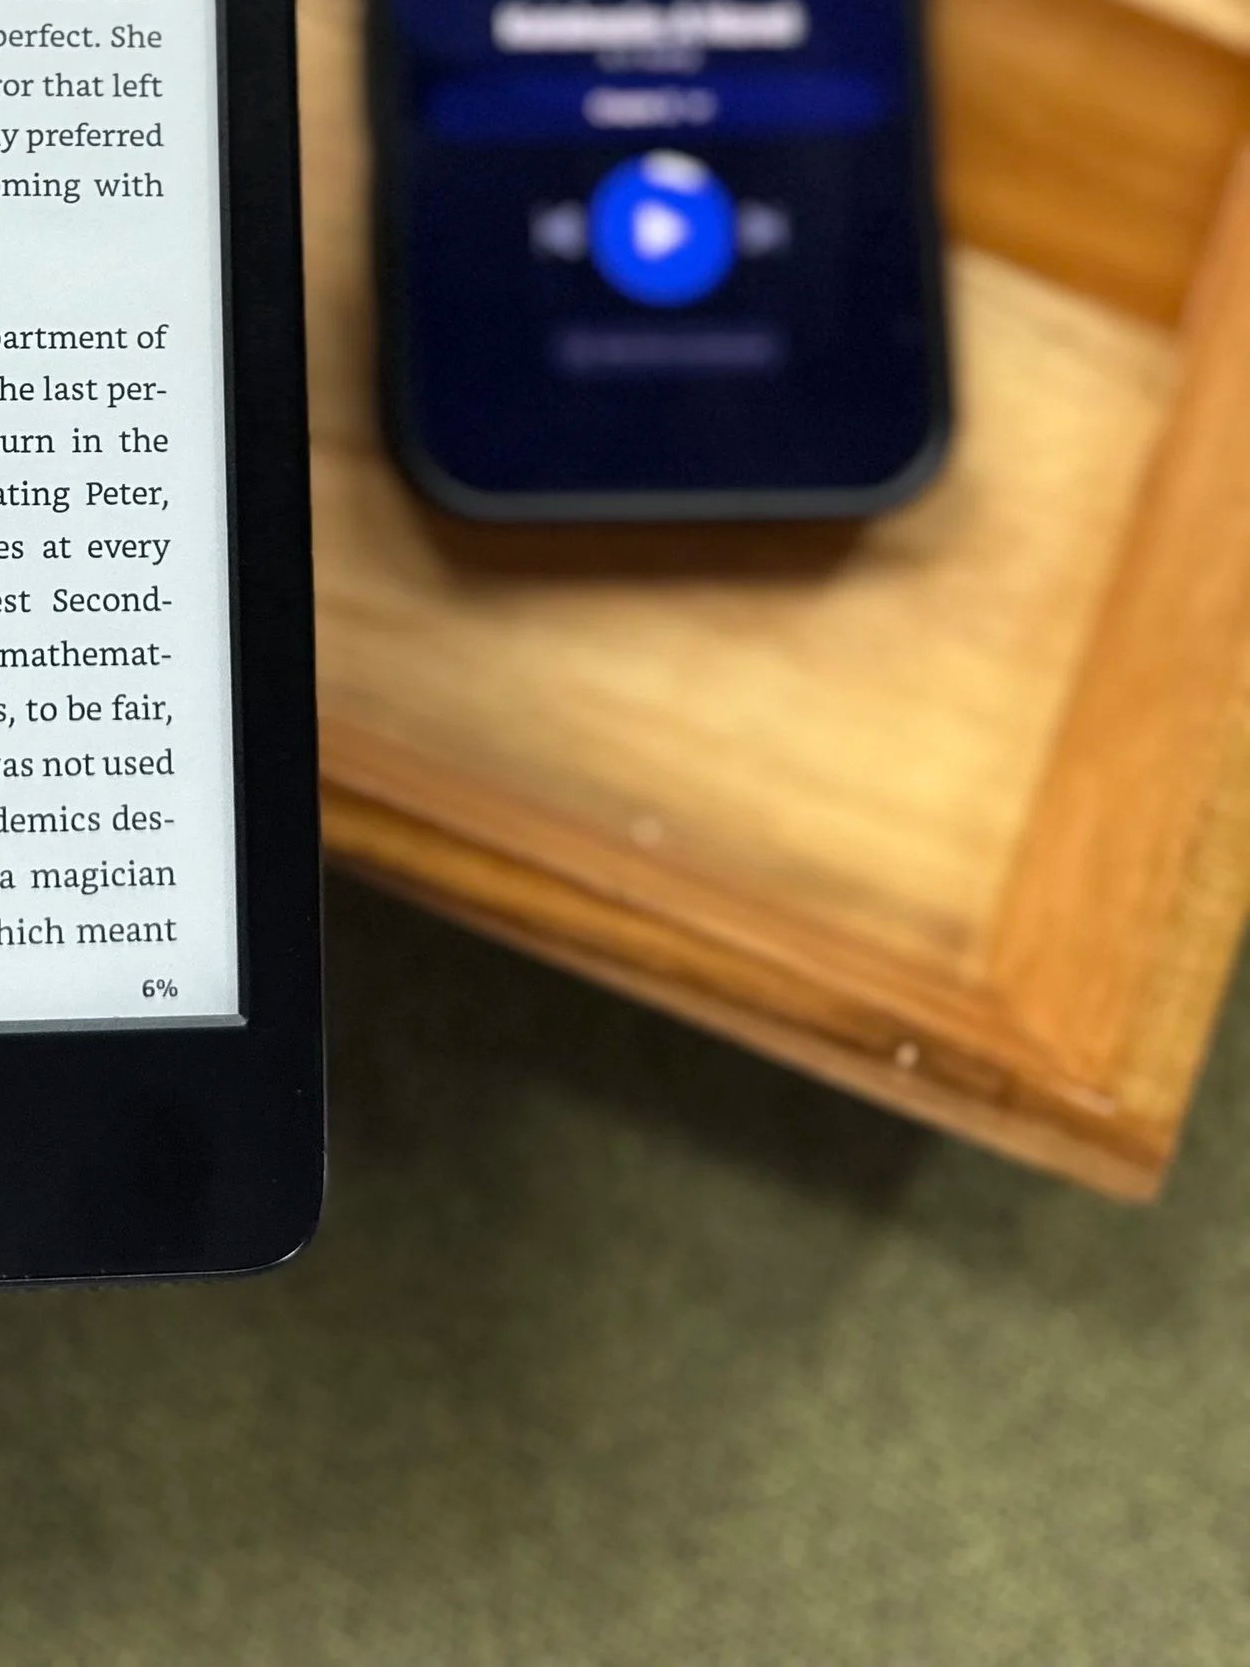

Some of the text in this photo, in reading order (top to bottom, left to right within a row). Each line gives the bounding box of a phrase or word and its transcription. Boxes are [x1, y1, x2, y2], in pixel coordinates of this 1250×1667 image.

[110, 23, 163, 49] She
[41, 71, 105, 98] that
[111, 72, 164, 98] left
[25, 121, 165, 155] preferred
[93, 171, 165, 198] with
[136, 323, 170, 350] of
[42, 374, 99, 402] last
[106, 381, 168, 409] per-
[71, 426, 104, 454] in
[117, 426, 169, 454] the
[85, 481, 169, 512] Peter,
[42, 536, 73, 560] at
[87, 538, 172, 567] every
[52, 584, 173, 614] Second-
[25, 698, 58, 723] to
[65, 693, 103, 722] be
[110, 692, 173, 727] fair,
[111, 803, 175, 832] des-
[29, 858, 177, 897] magician
[75, 918, 178, 945] meant
[141, 978, 179, 999] 6%
